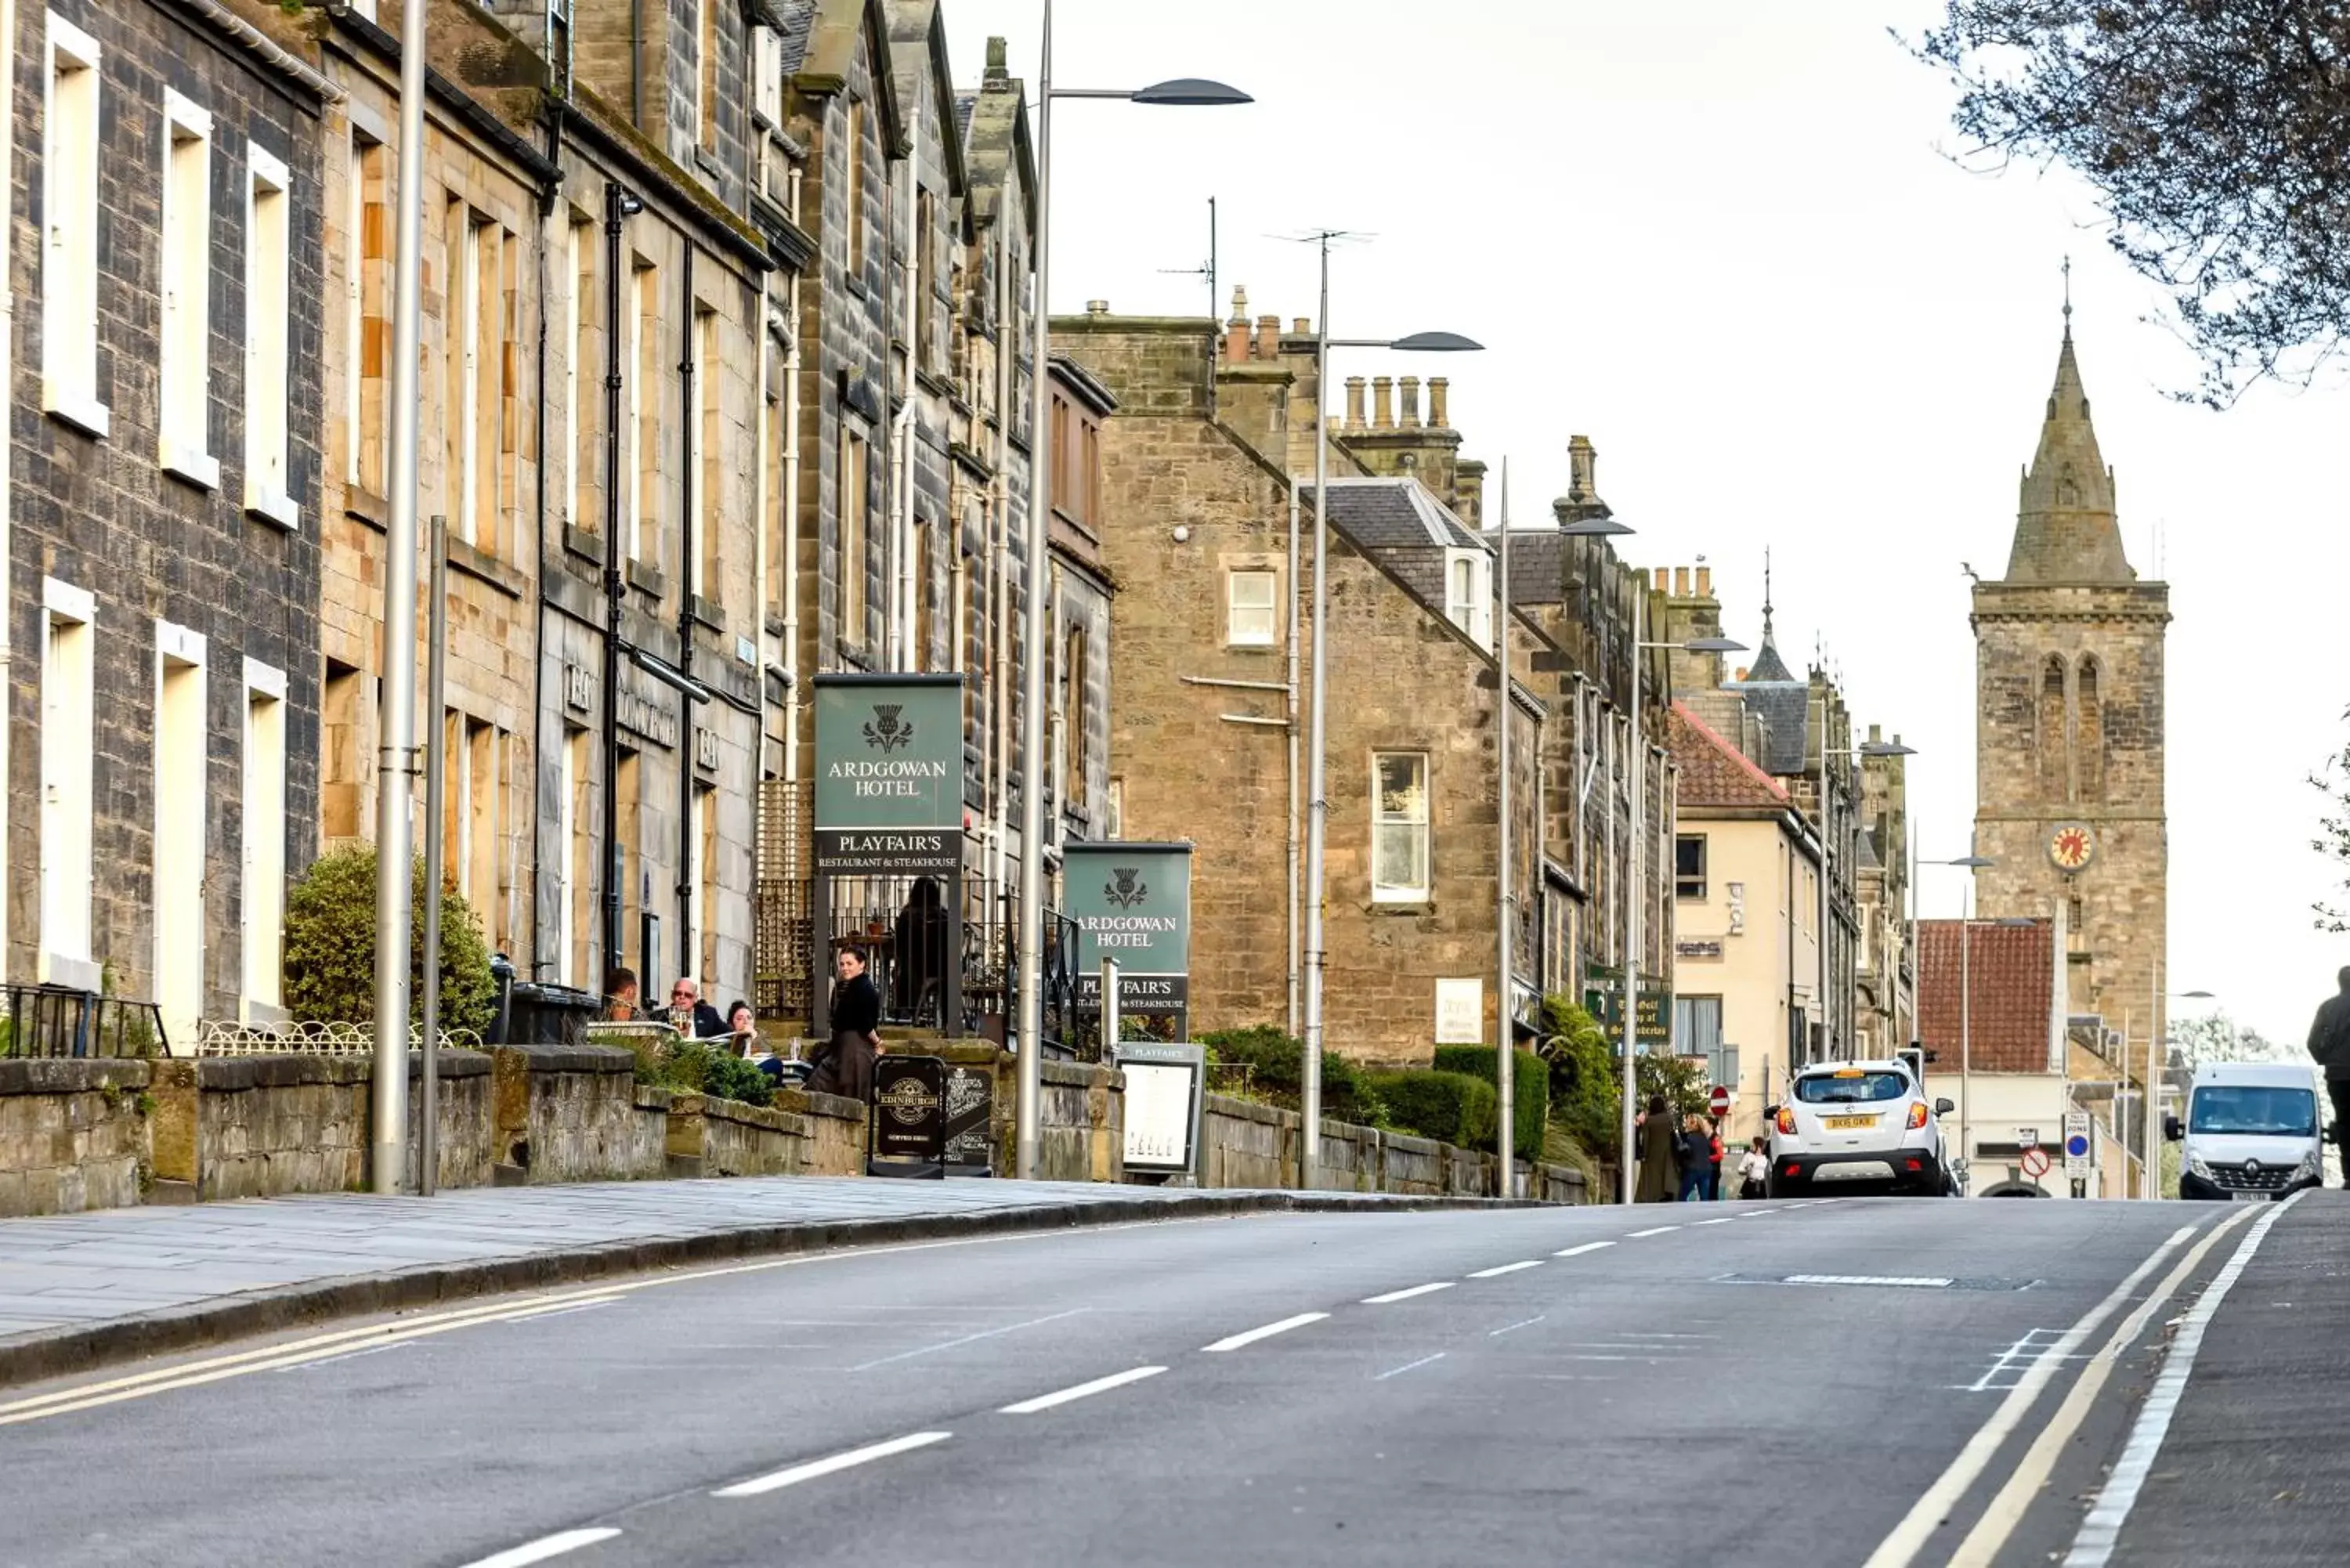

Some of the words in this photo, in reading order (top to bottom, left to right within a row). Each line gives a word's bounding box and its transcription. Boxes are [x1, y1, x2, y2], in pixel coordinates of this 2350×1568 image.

[829, 761, 946, 778] ARDGOWAN
[855, 779, 921, 797] HOTEL
[839, 835, 942, 851] PLAYFAIR'S
[819, 857, 881, 868] RESTAURANT
[883, 858, 892, 867] &
[894, 858, 957, 868] STEAKHOUSE
[1097, 933, 1154, 947] HOTEL
[1130, 999, 1184, 1009] STEAKHOUSE
[880, 1096, 938, 1105] EDINBURGH
